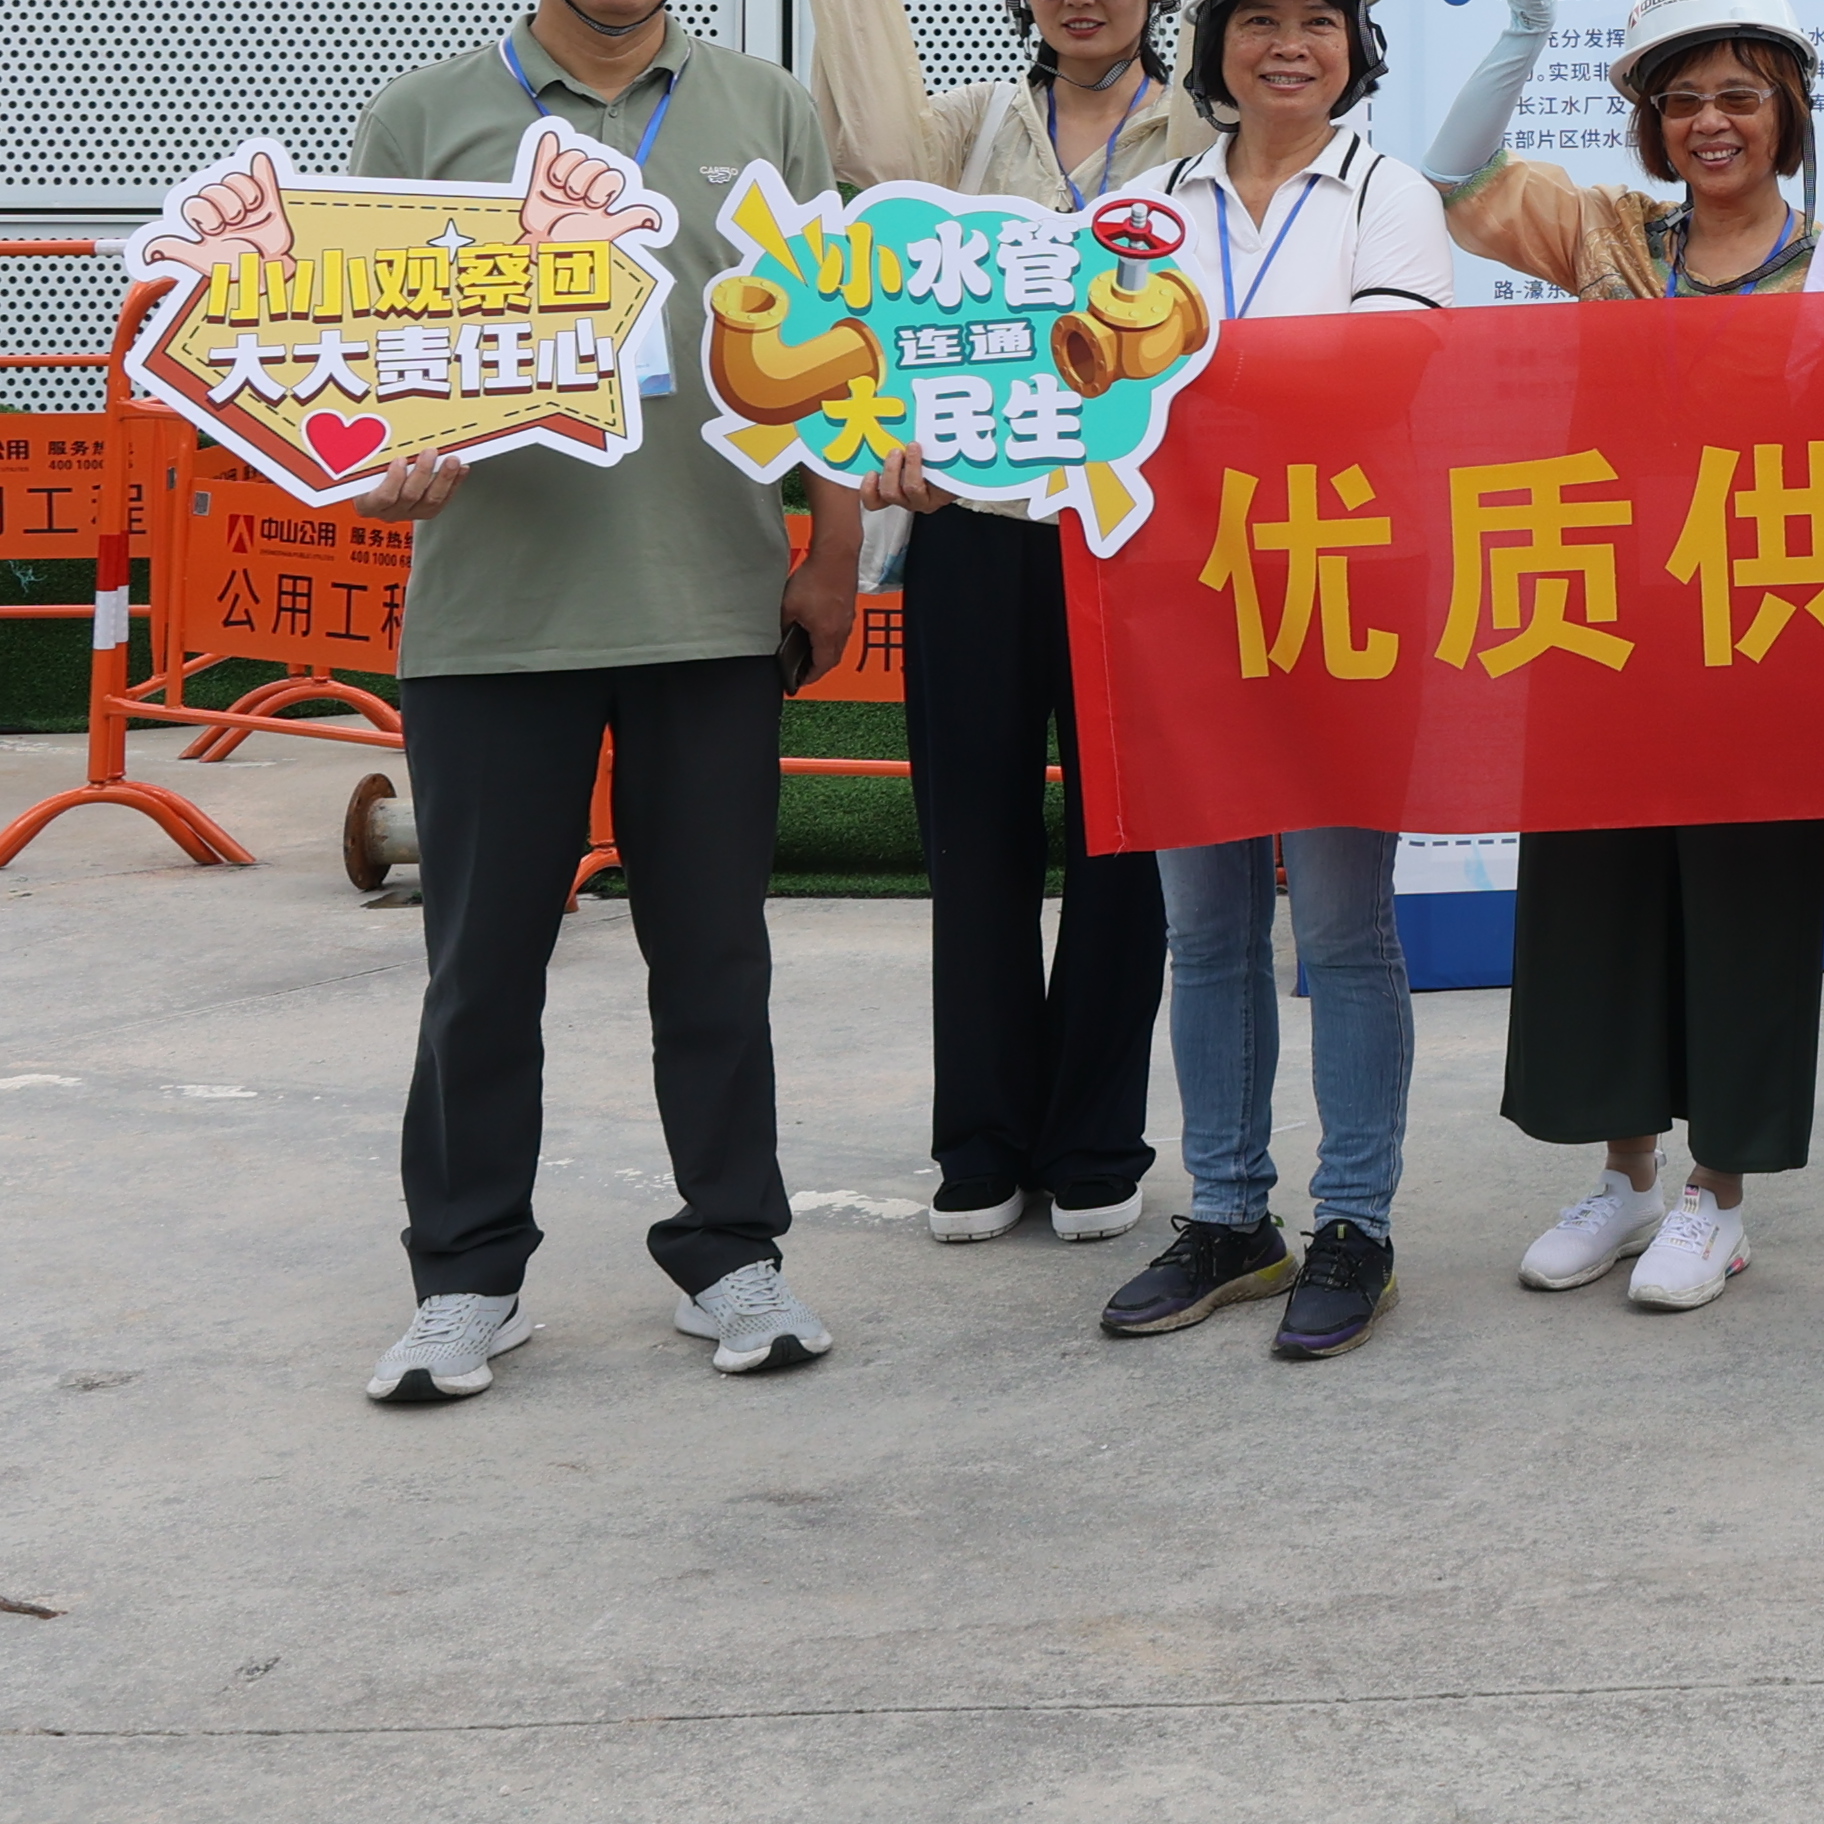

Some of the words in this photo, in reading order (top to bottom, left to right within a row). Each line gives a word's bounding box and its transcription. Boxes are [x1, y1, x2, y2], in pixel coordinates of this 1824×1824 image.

[1516, 95, 1626, 115] 长江水厂及
[205, 240, 613, 326] 小小观察团
[815, 219, 1082, 313] 小水管
[206, 318, 615, 409] 大大责任心
[898, 320, 1032, 366] 连通
[820, 373, 1087, 465] 大民生
[48, 459, 73, 471] 400
[260, 517, 336, 548] 中山公用
[350, 551, 370, 564] 400
[372, 553, 398, 567] 1000
